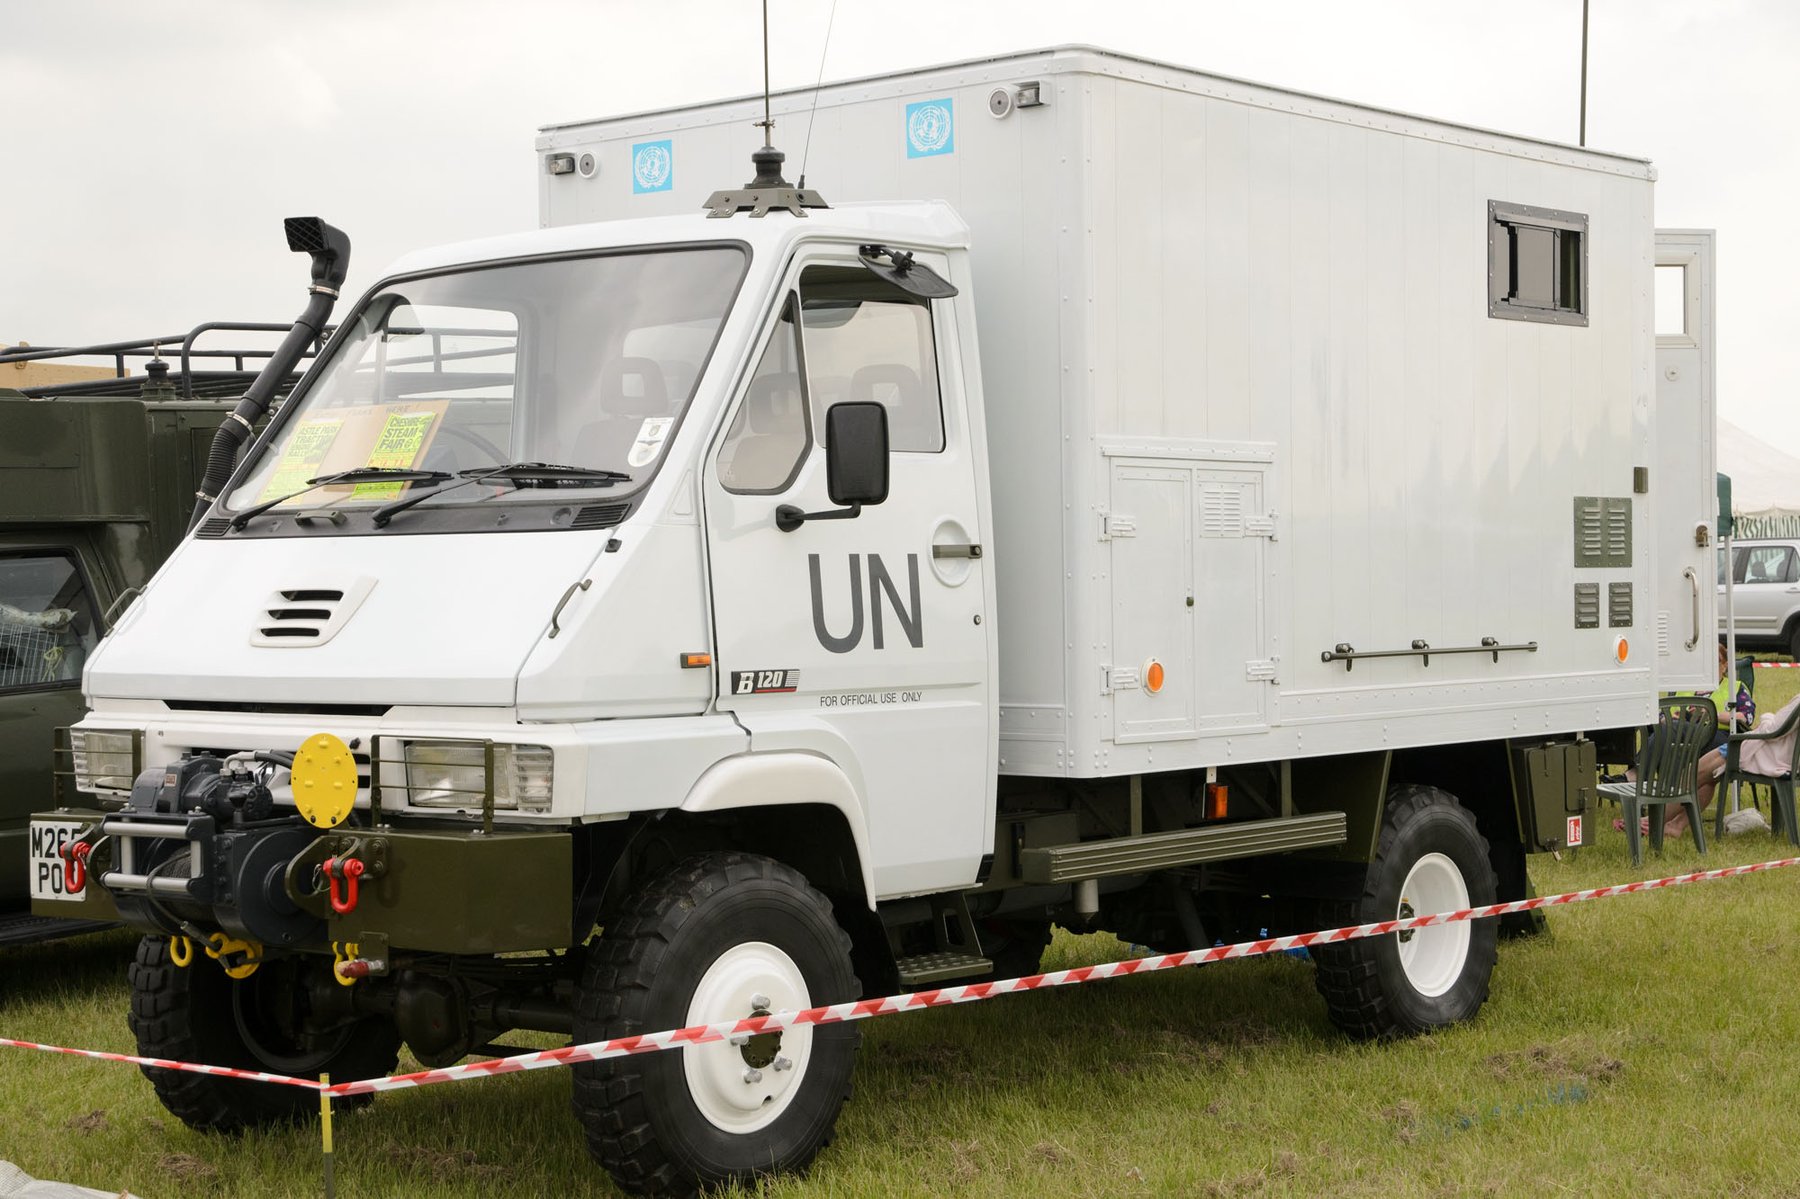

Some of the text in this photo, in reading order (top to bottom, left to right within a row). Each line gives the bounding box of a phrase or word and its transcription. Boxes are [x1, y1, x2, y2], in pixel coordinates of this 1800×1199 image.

[384, 427, 419, 438] STEAM
[379, 438, 406, 449] FAIR
[808, 553, 924, 654] UN
[820, 691, 923, 707] FOR OFFICIAL USE ONLY
